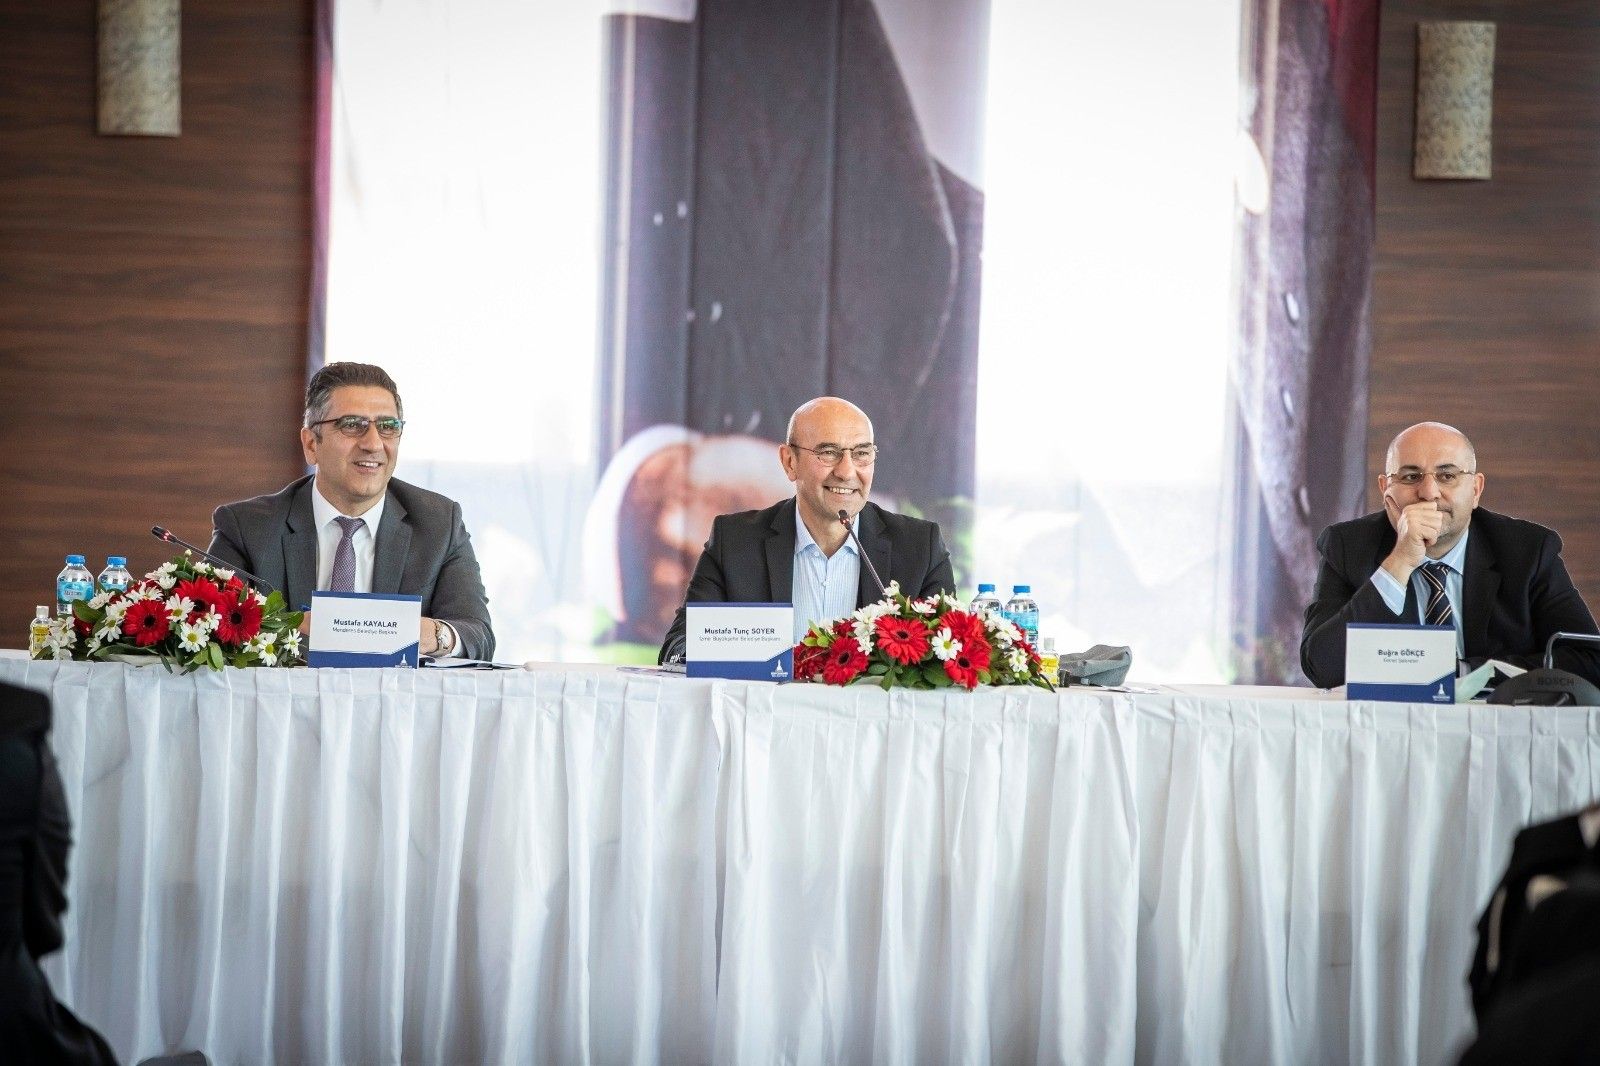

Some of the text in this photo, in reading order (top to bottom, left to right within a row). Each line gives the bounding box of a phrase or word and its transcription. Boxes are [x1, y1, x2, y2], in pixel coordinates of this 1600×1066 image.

[363, 620, 397, 628] KAYALAR
[704, 627, 732, 635] Mustafa
[1378, 649, 1425, 658] Buğra GÖKÇE
